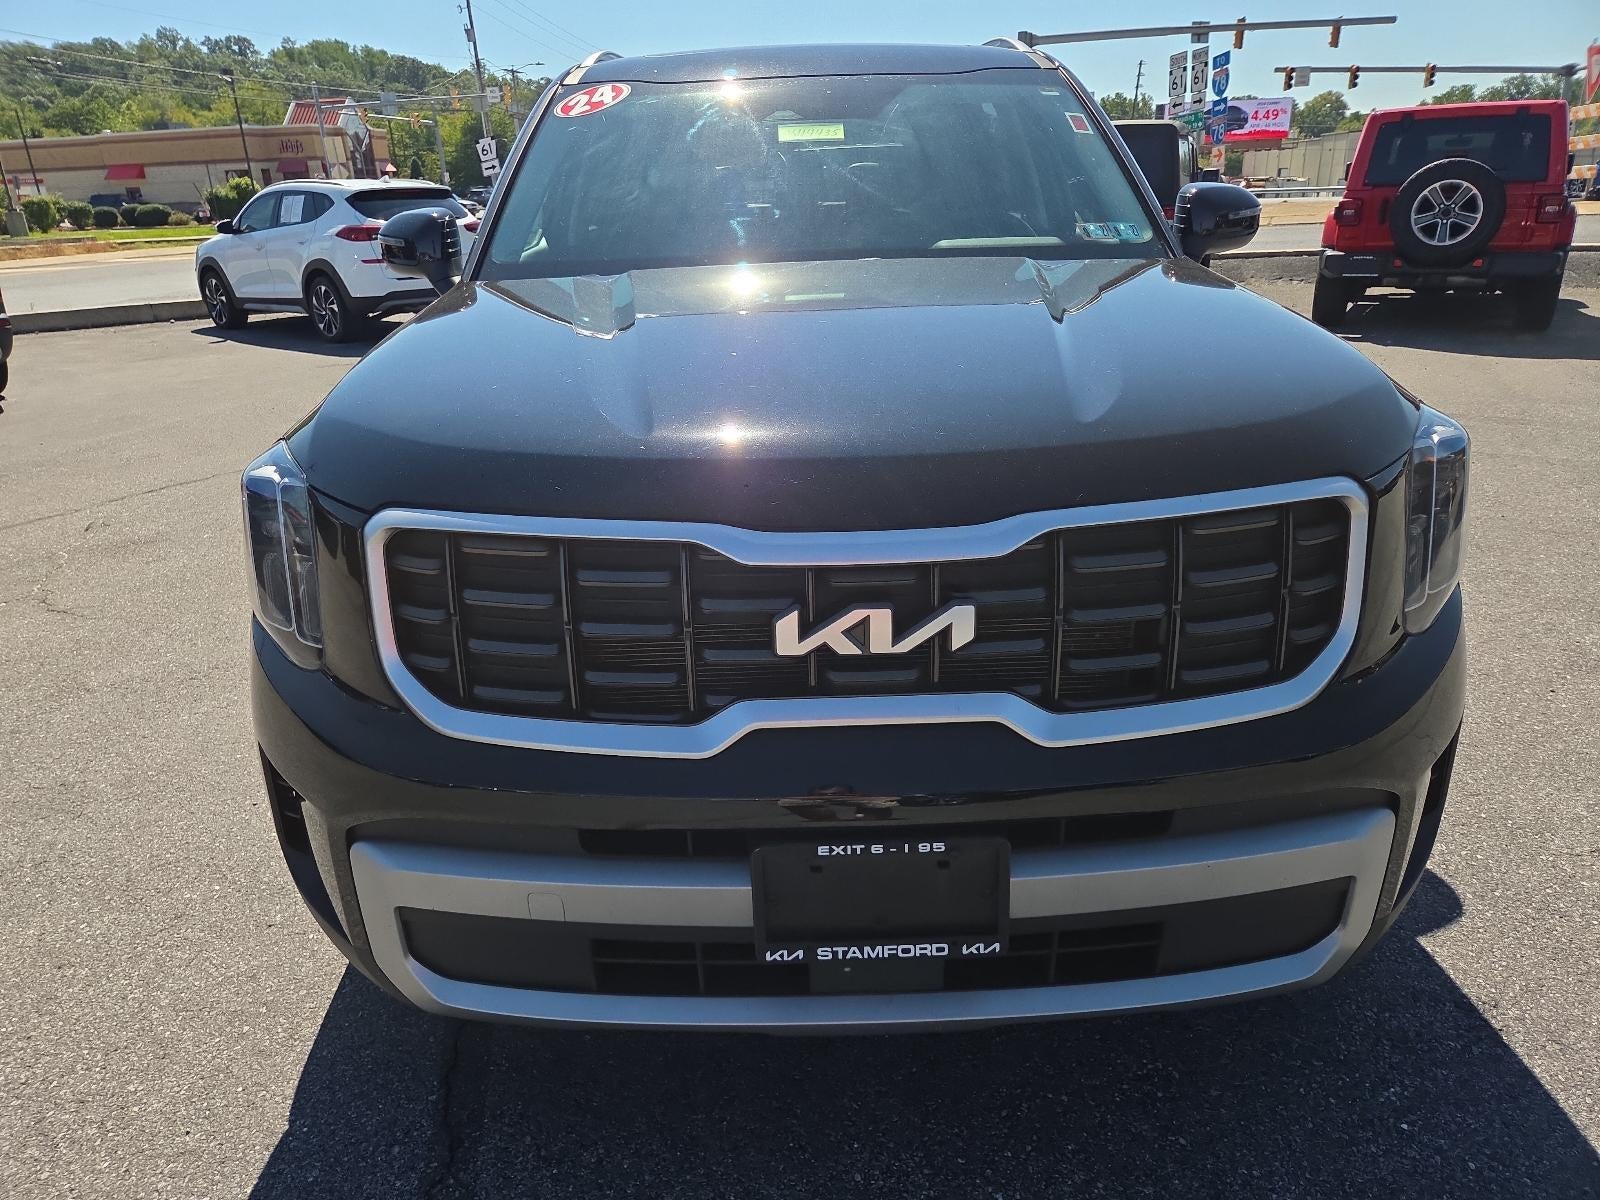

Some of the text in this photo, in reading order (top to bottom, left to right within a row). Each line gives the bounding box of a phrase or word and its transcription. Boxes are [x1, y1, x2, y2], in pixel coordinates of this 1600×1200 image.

[1171, 55, 1187, 66] SOUTH
[1193, 50, 1209, 61] NORTH
[1216, 56, 1226, 66] TO
[1171, 74, 1183, 91] 61
[1193, 69, 1204, 85] 61
[1214, 75, 1227, 93] 78
[567, 85, 617, 115] 24
[1251, 107, 1287, 121] 4.49%
[1212, 123, 1225, 142] 78
[481, 142, 493, 156] 61
[775, 604, 977, 657] KIA
[817, 844, 865, 856] EXIT
[870, 843, 884, 855] 6
[918, 842, 946, 853] 95
[765, 942, 1000, 962] KIA STAMFORD KIA
